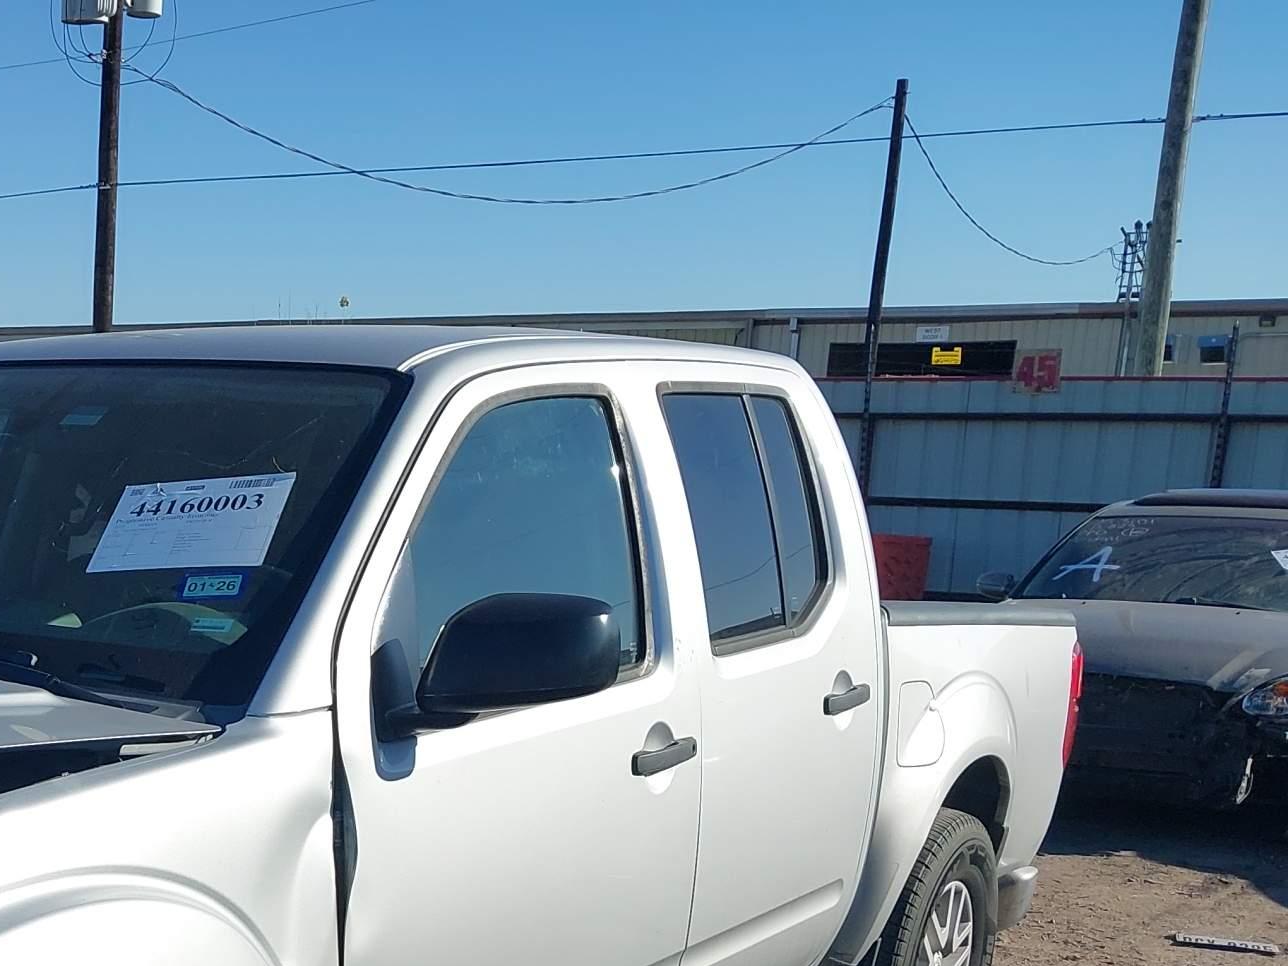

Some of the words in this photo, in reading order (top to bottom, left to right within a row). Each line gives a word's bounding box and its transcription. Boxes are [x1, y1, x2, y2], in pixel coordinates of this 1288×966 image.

[1016, 353, 1061, 393] 45
[130, 492, 265, 518] 44160003
[1053, 546, 1120, 582] A
[187, 582, 206, 592] 01
[215, 581, 237, 591] 26
